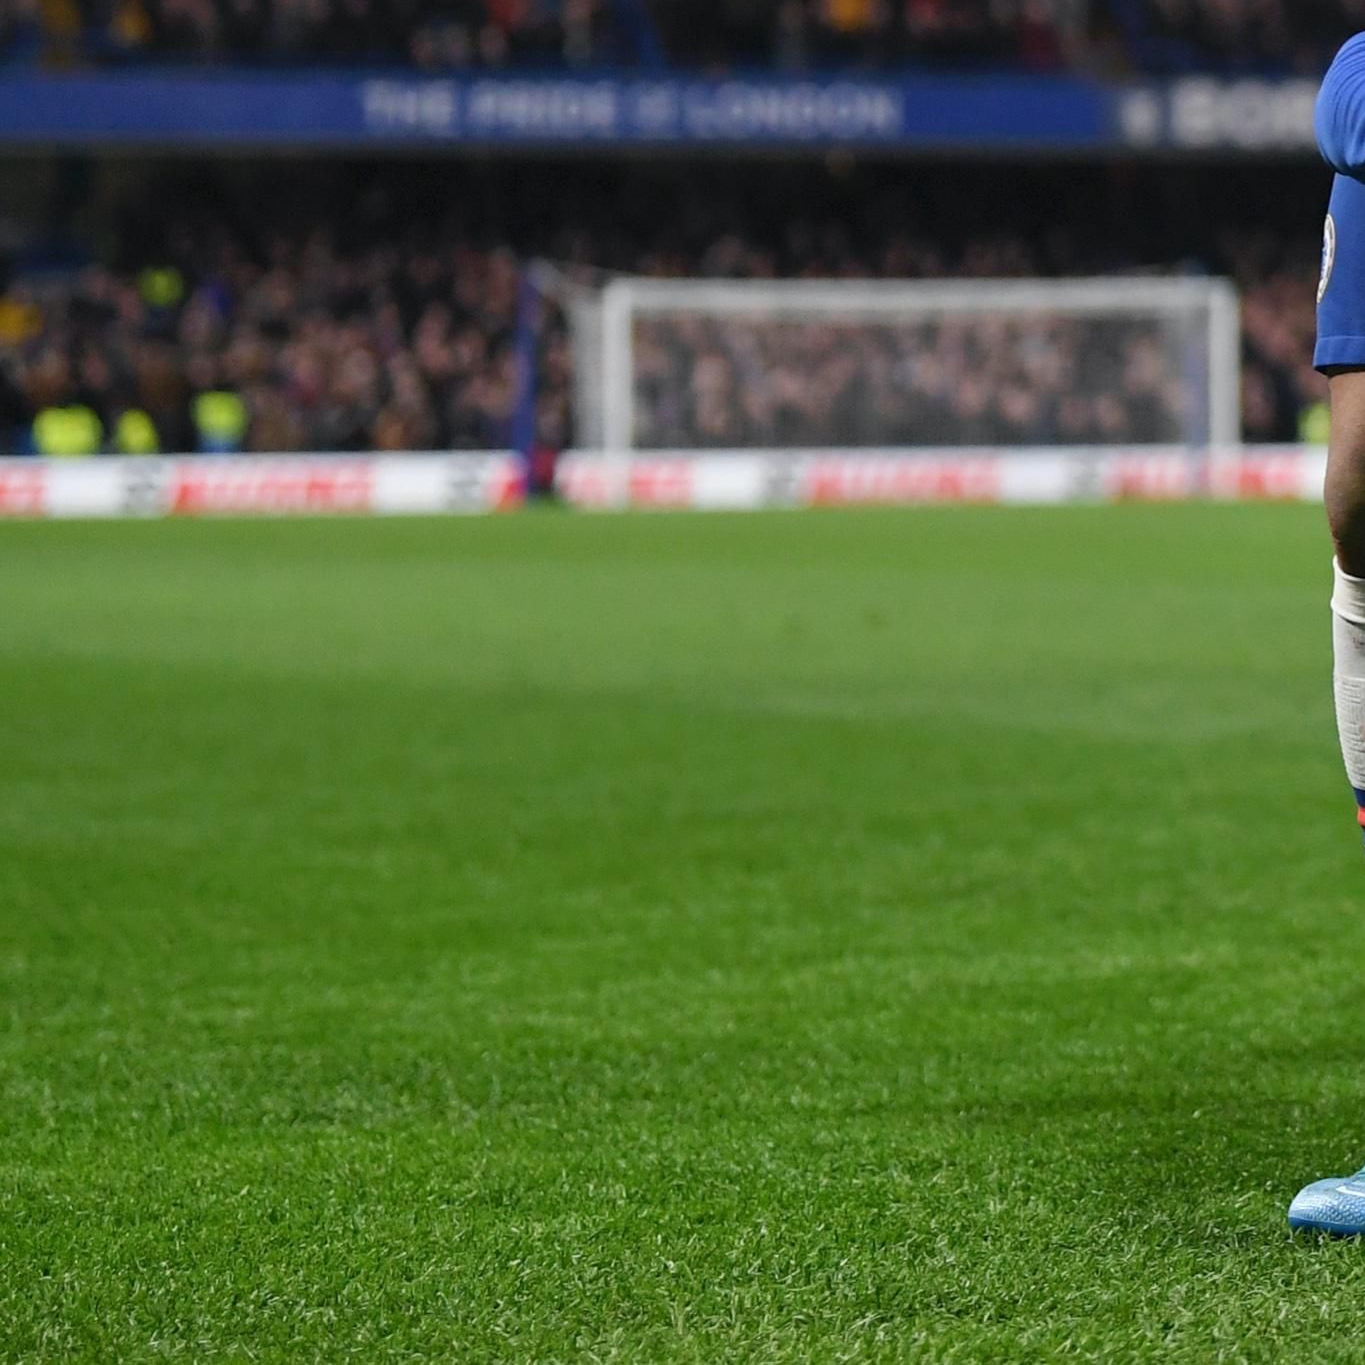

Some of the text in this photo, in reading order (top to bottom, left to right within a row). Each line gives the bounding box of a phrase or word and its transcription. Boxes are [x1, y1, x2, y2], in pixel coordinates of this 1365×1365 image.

[362, 79, 454, 135] THE
[467, 80, 617, 135] PRIDE
[684, 81, 899, 136] LONDON
